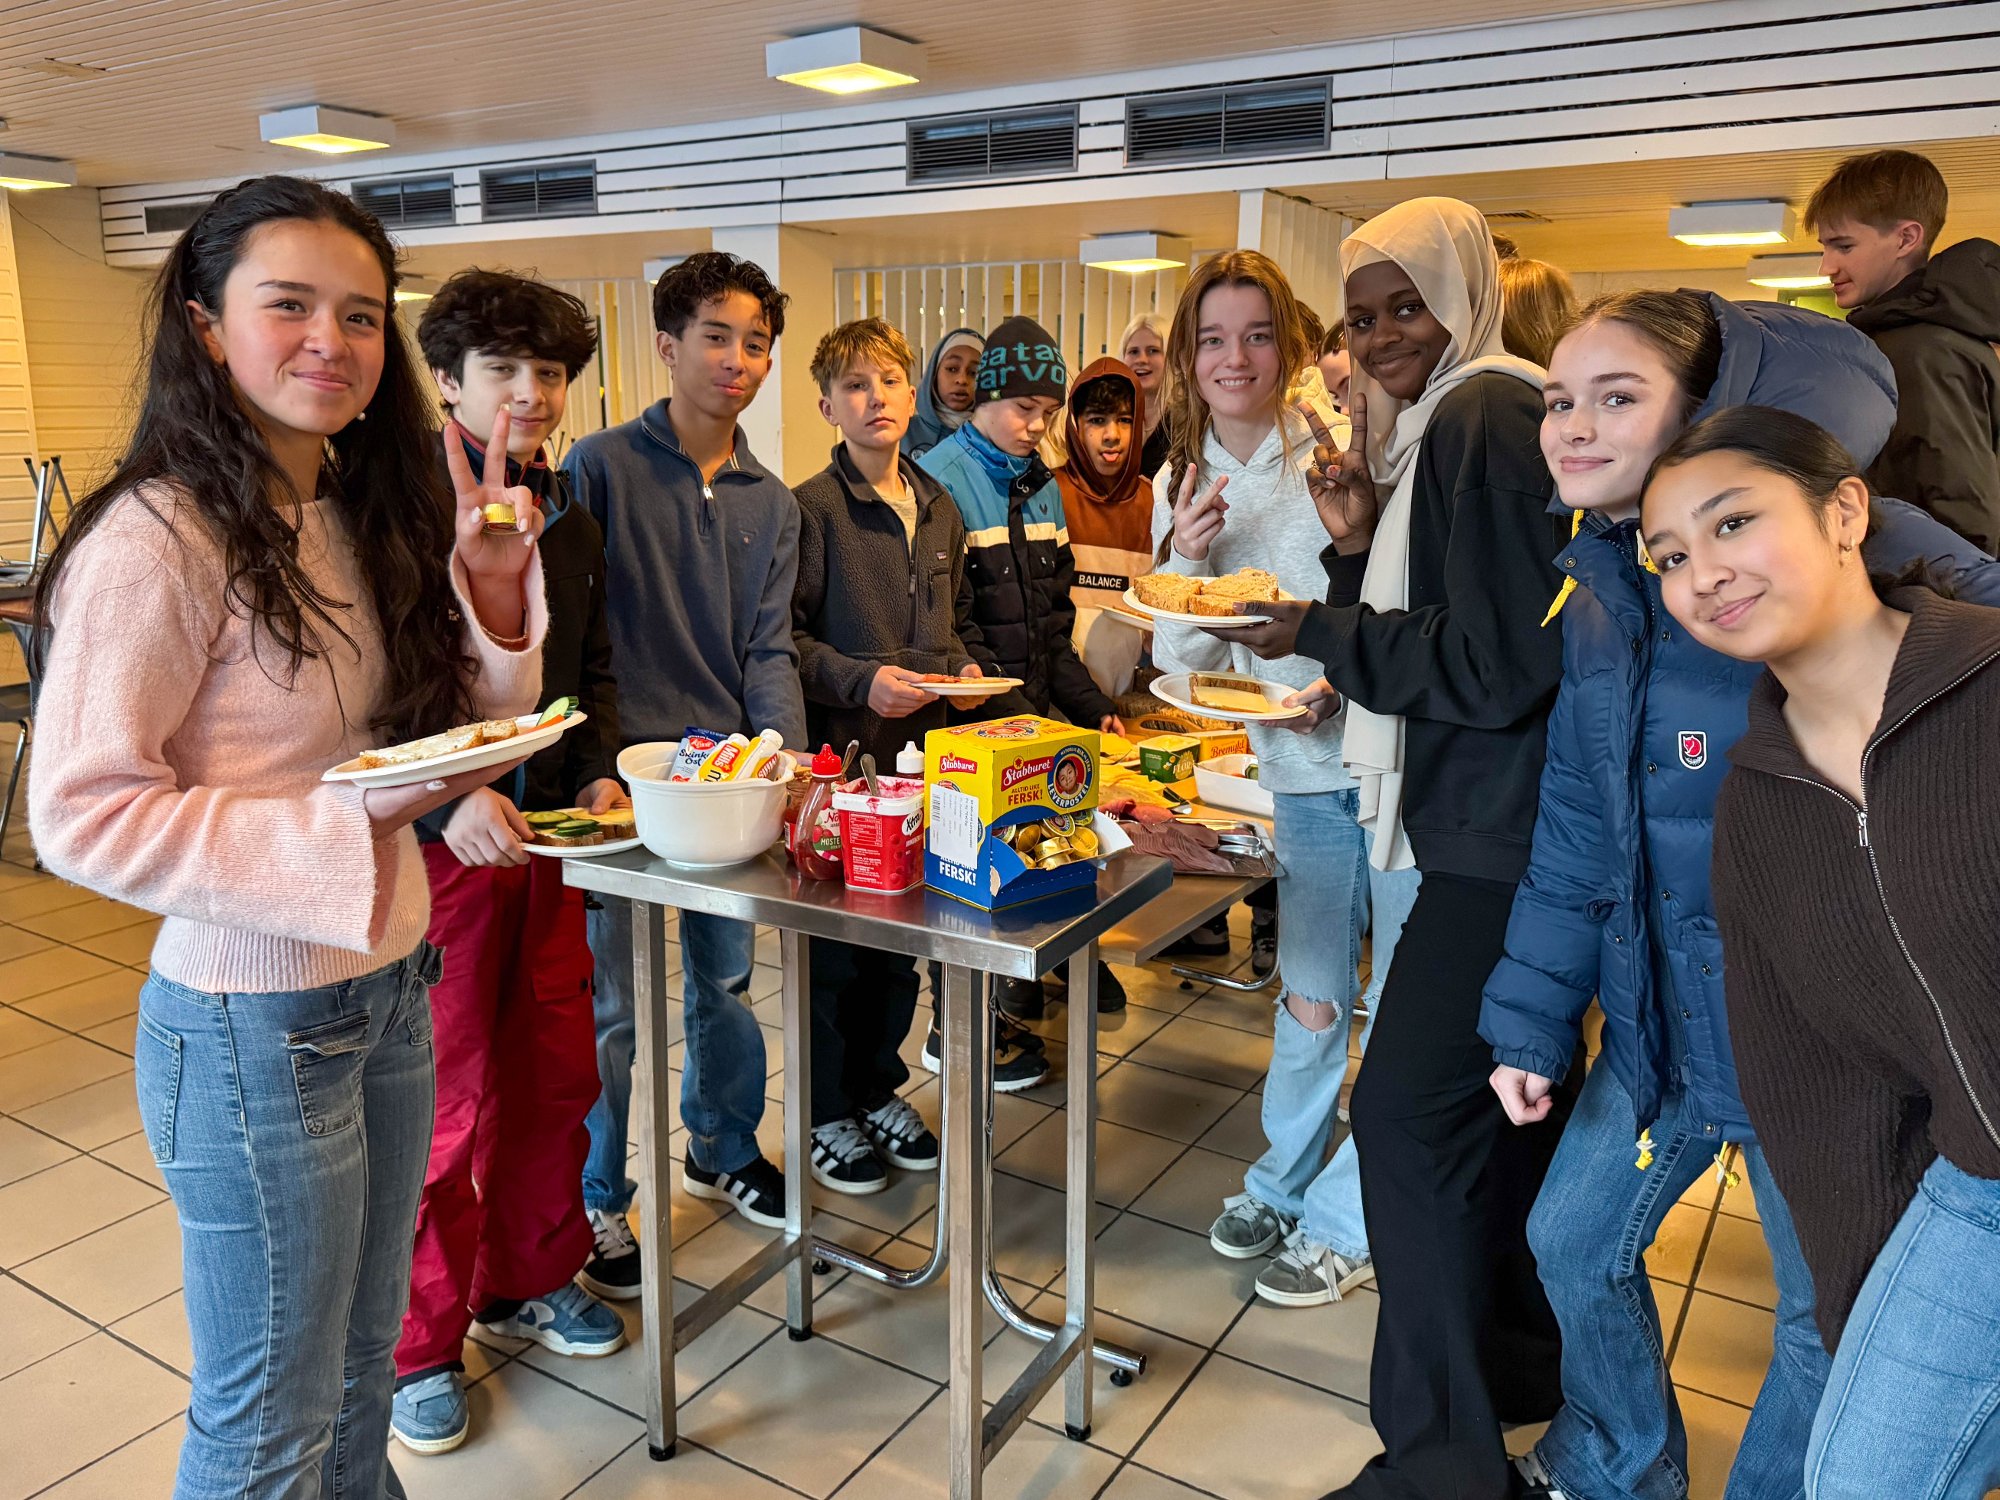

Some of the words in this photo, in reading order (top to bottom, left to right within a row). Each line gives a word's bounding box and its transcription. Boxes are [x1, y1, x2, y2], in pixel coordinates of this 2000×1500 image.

[977, 363, 1065, 389] arvo
[1078, 574, 1122, 588] BALANCE
[679, 748, 710, 760] Skink
[715, 745, 738, 767] Mills
[941, 757, 975, 771] Stabburet
[1003, 759, 1051, 786] Stabburet
[1008, 789, 1043, 805] FERSK!
[1012, 785, 1029, 793] ALLTID
[1047, 783, 1089, 808] LEVERPOSTEI
[906, 813, 922, 833] Xtra
[940, 860, 977, 886] FERSK!
